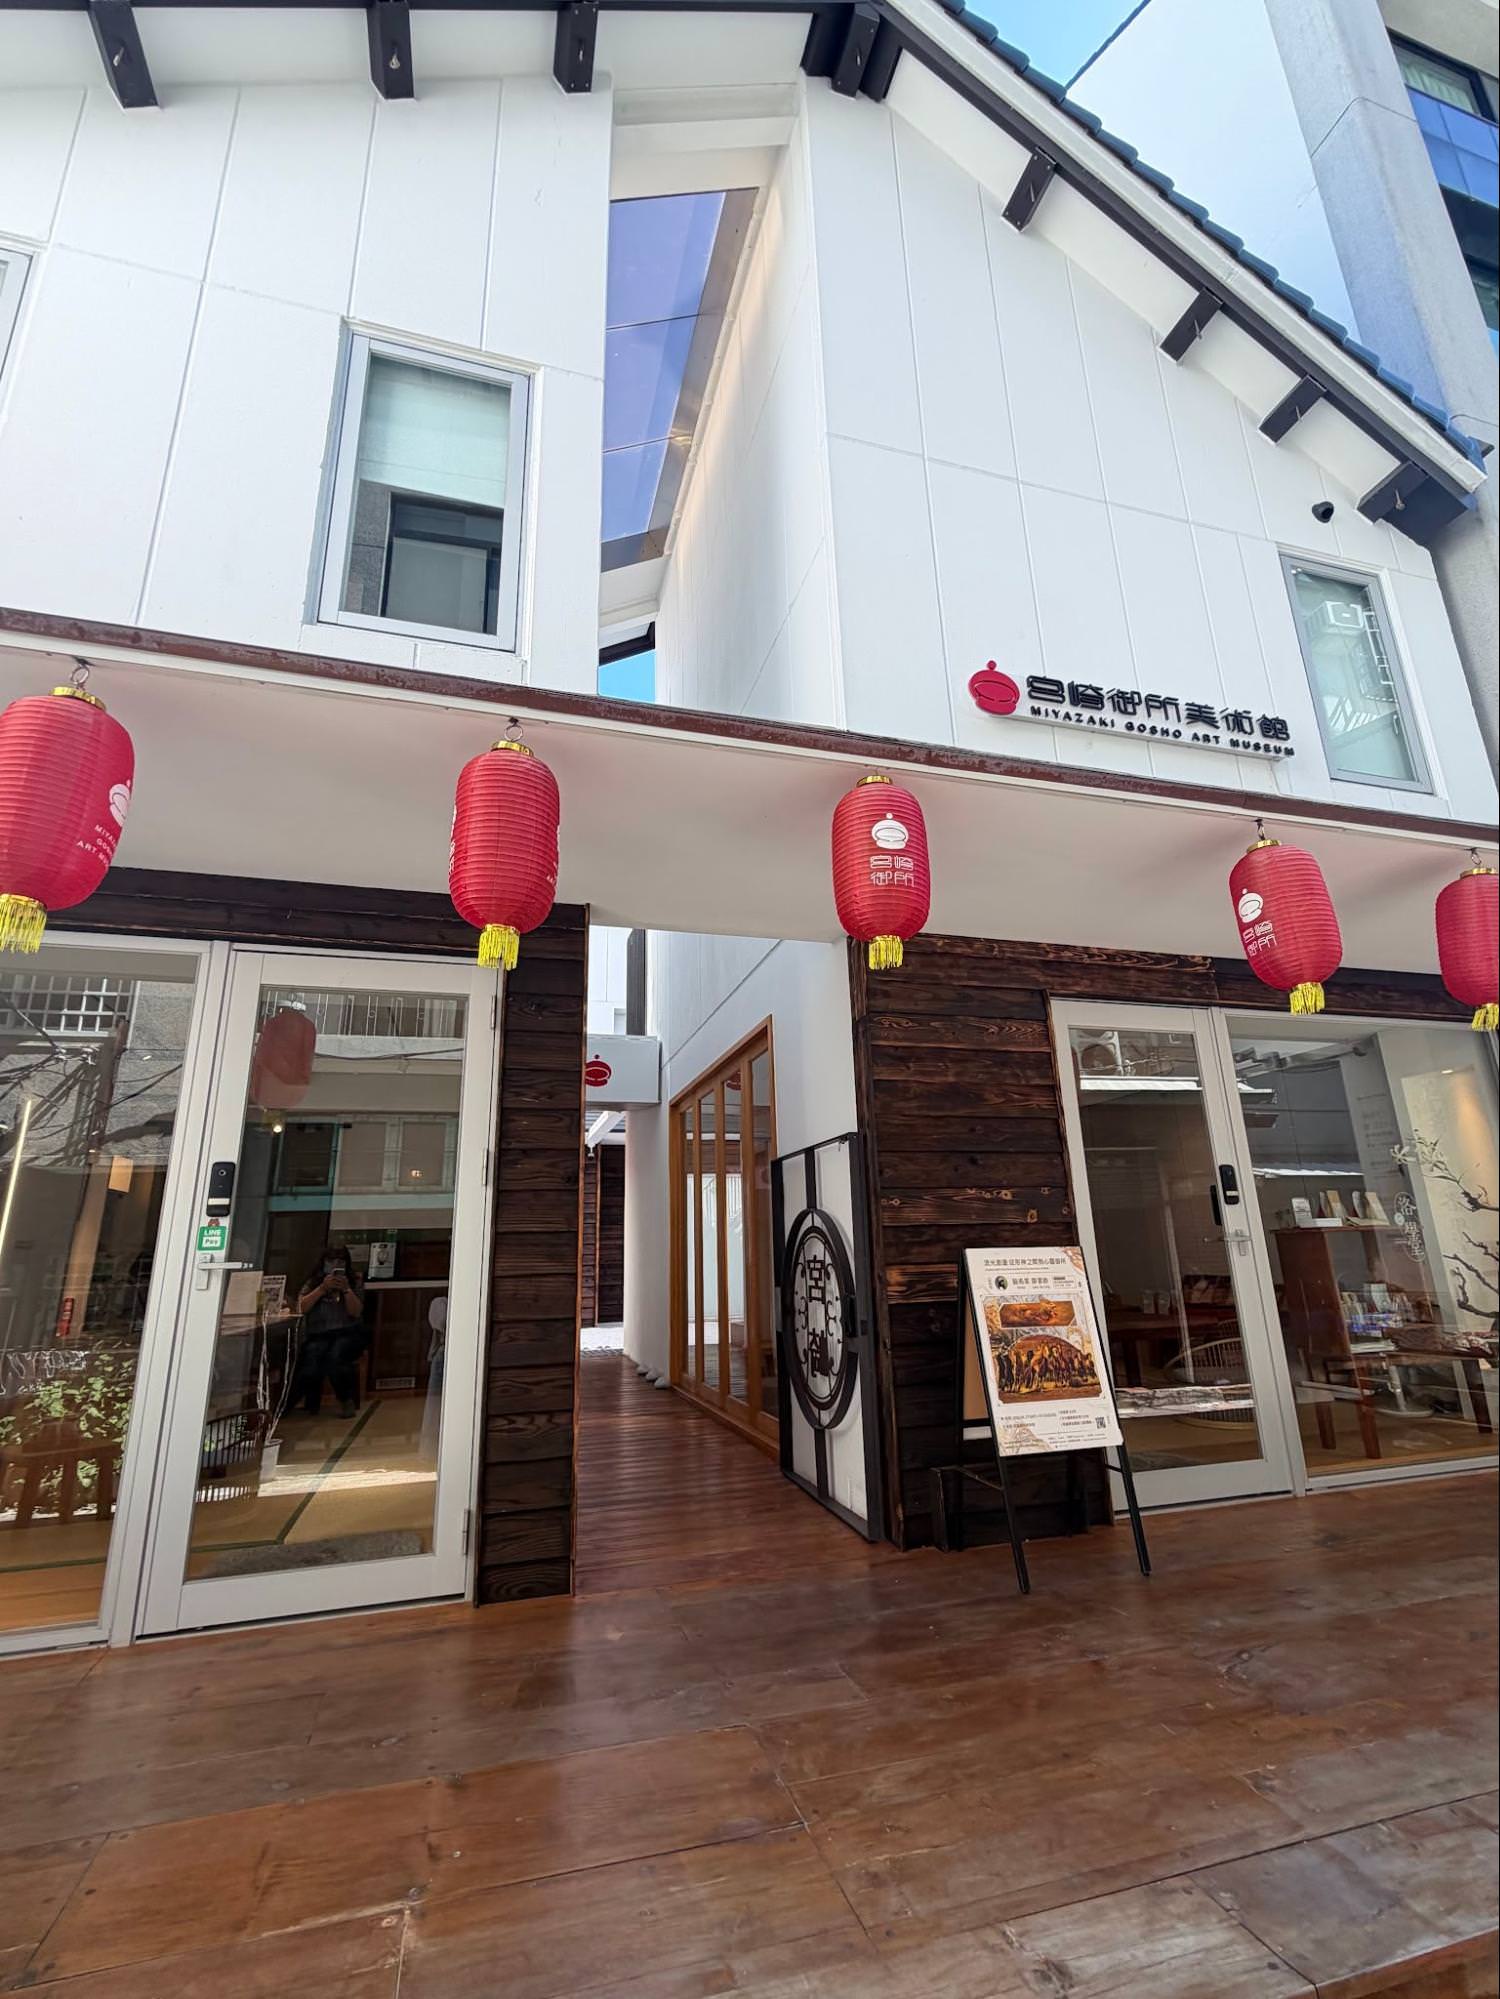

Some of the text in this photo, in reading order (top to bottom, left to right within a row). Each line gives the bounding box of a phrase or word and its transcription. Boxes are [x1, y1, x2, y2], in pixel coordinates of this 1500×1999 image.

[1029, 705, 1295, 757] MIYAZAKI GOSHO ART MUSEUM
[76, 840, 97, 853] ART
